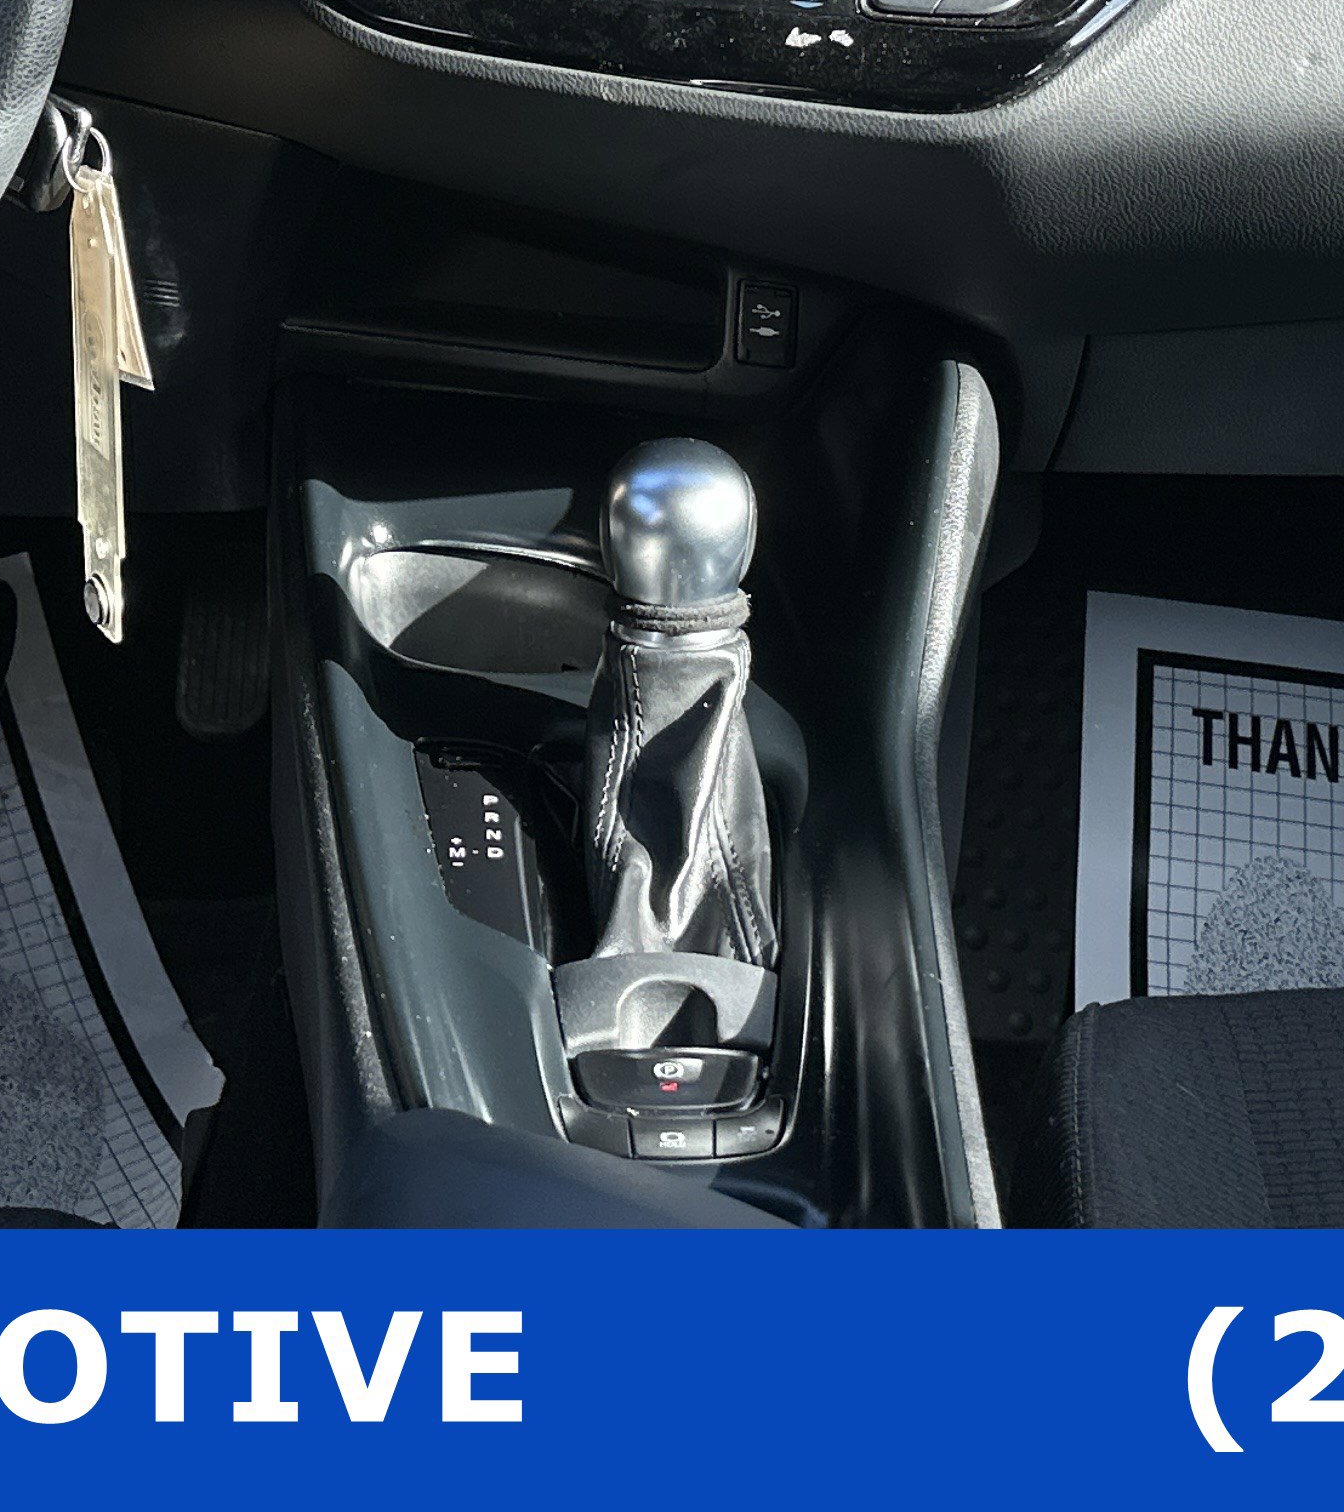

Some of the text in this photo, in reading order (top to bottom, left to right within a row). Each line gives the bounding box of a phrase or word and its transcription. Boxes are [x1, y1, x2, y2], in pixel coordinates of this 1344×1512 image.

[483, 794, 499, 806] P
[484, 811, 500, 823] R
[486, 828, 502, 841] N
[449, 847, 466, 858] M
[487, 846, 504, 859] D
